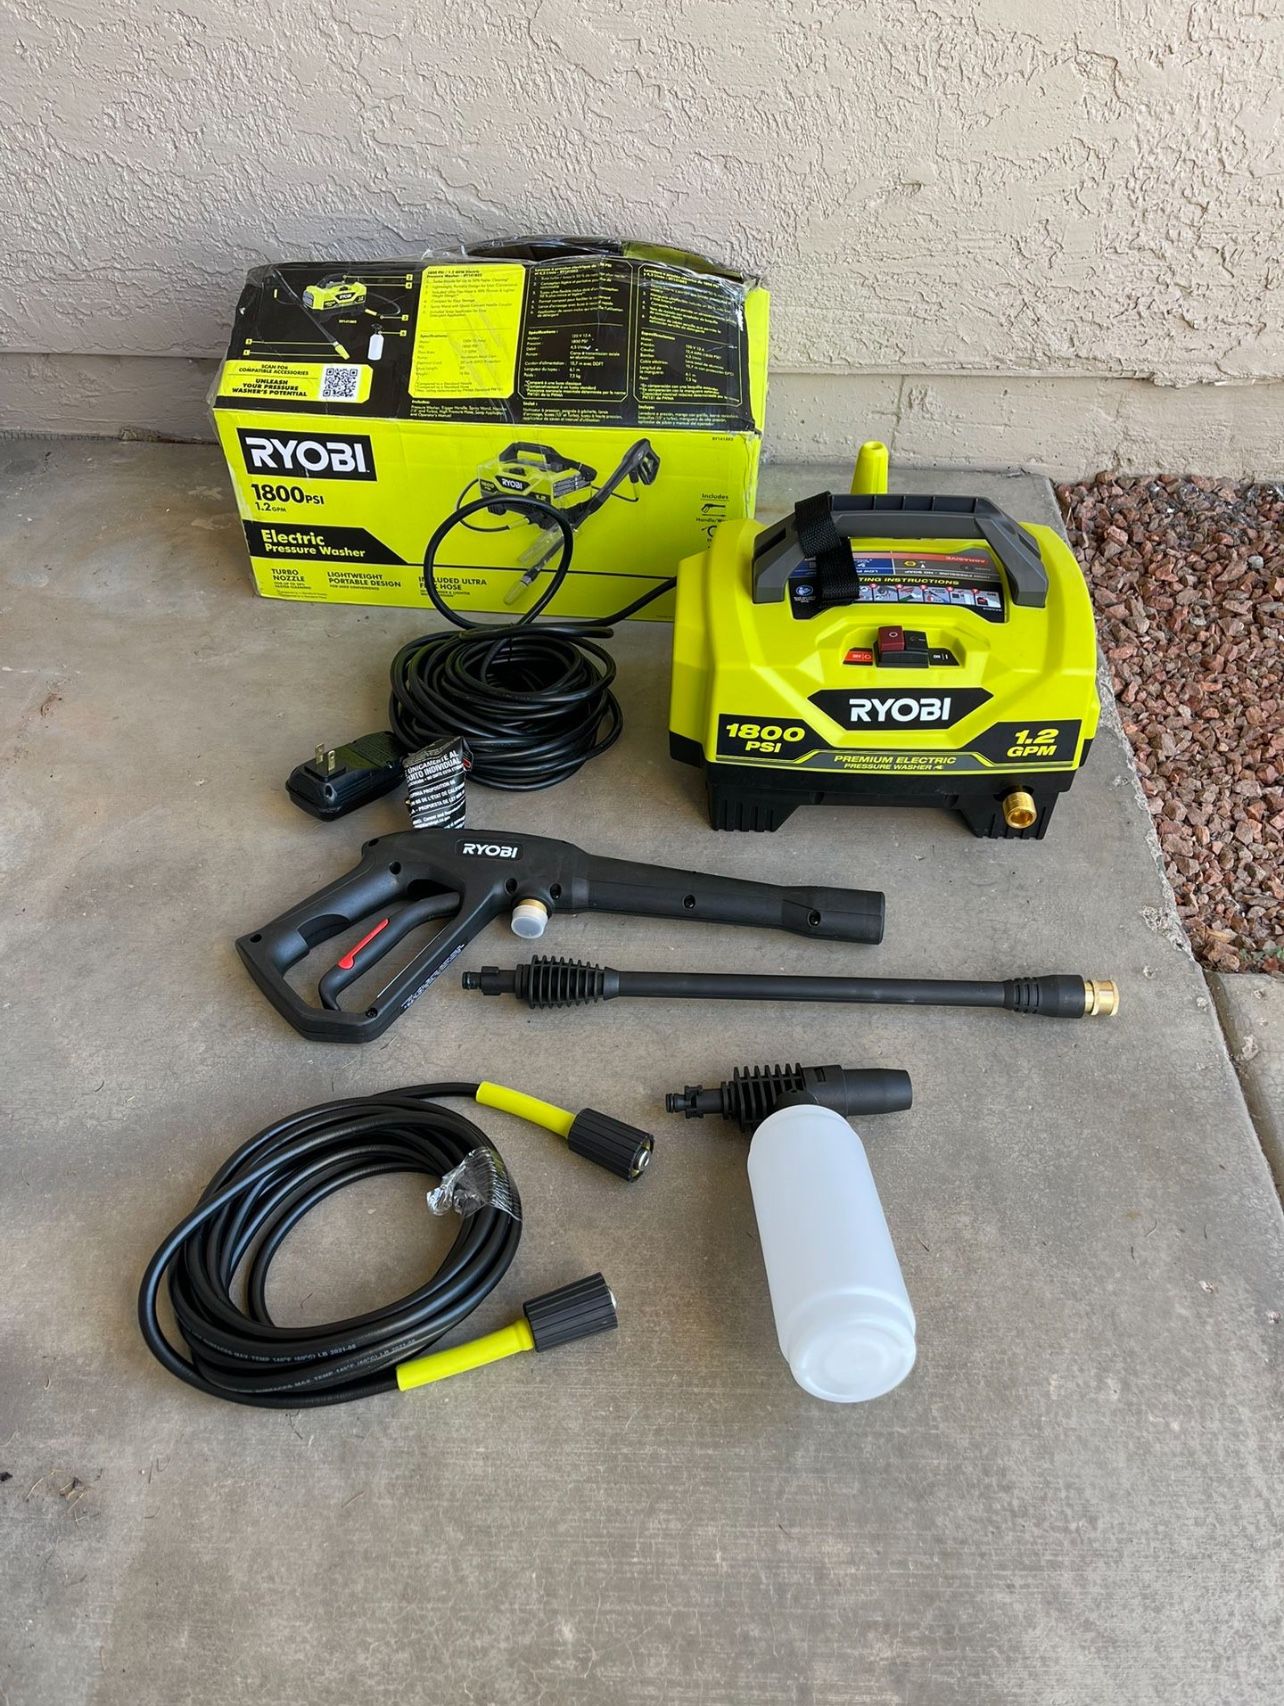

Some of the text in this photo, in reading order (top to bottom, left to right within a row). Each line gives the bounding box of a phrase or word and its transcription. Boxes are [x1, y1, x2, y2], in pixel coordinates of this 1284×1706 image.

[245, 437, 366, 473] RYOBI
[501, 478, 523, 490] RYOBI
[261, 529, 325, 545] Electric
[265, 543, 366, 557] Pressure Washer
[327, 572, 382, 580] LIGHTWEIGHT
[849, 697, 952, 723] RYOBI
[725, 722, 806, 743] 1800
[1014, 727, 1060, 745] 1.2
[744, 741, 783, 753] PSI
[1006, 744, 1058, 758] GPM
[449, 750, 459, 759] AL
[833, 755, 958, 766] PREMIUM ELECTRIC
[424, 758, 461, 776] INDIVIDUAL
[462, 843, 518, 858] RYOBI
